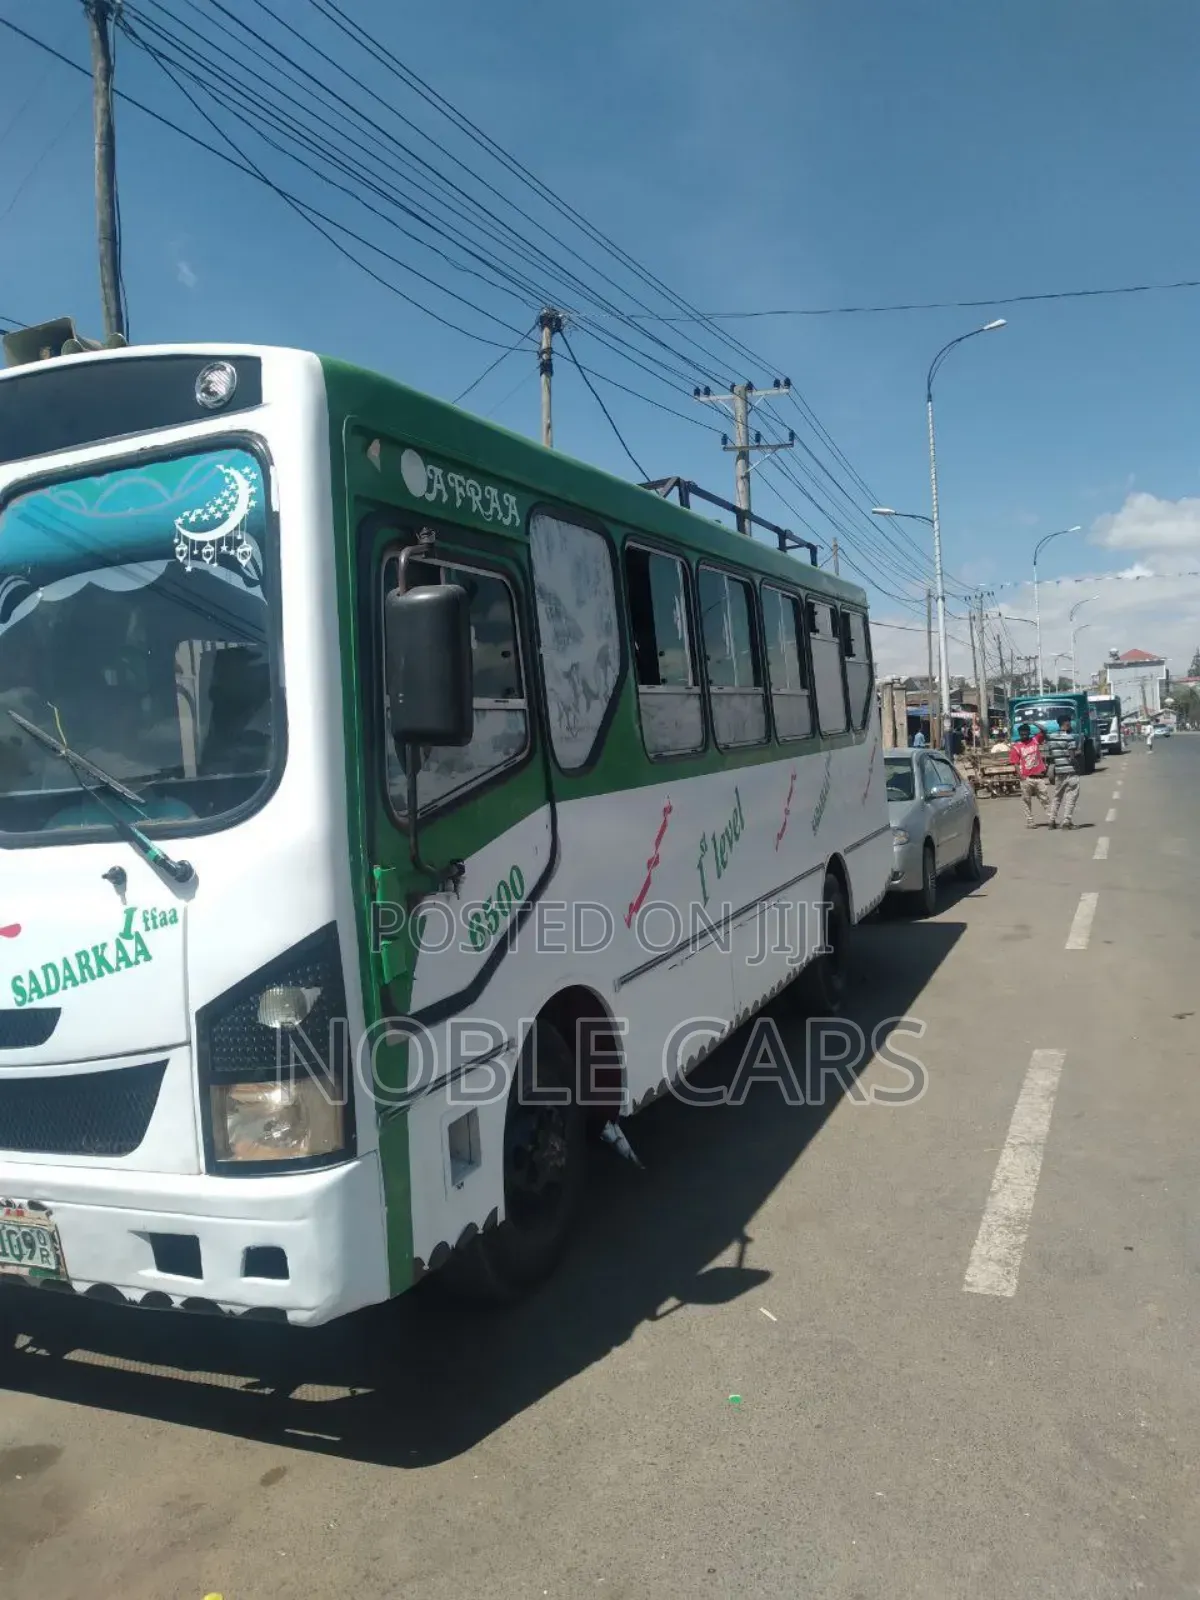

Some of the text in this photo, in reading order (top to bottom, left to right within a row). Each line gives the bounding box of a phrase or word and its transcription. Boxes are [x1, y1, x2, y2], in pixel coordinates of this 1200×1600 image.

[425, 464, 521, 527] AFRAA
[711, 784, 745, 880] level
[11, 931, 152, 1007] SADARKAA
